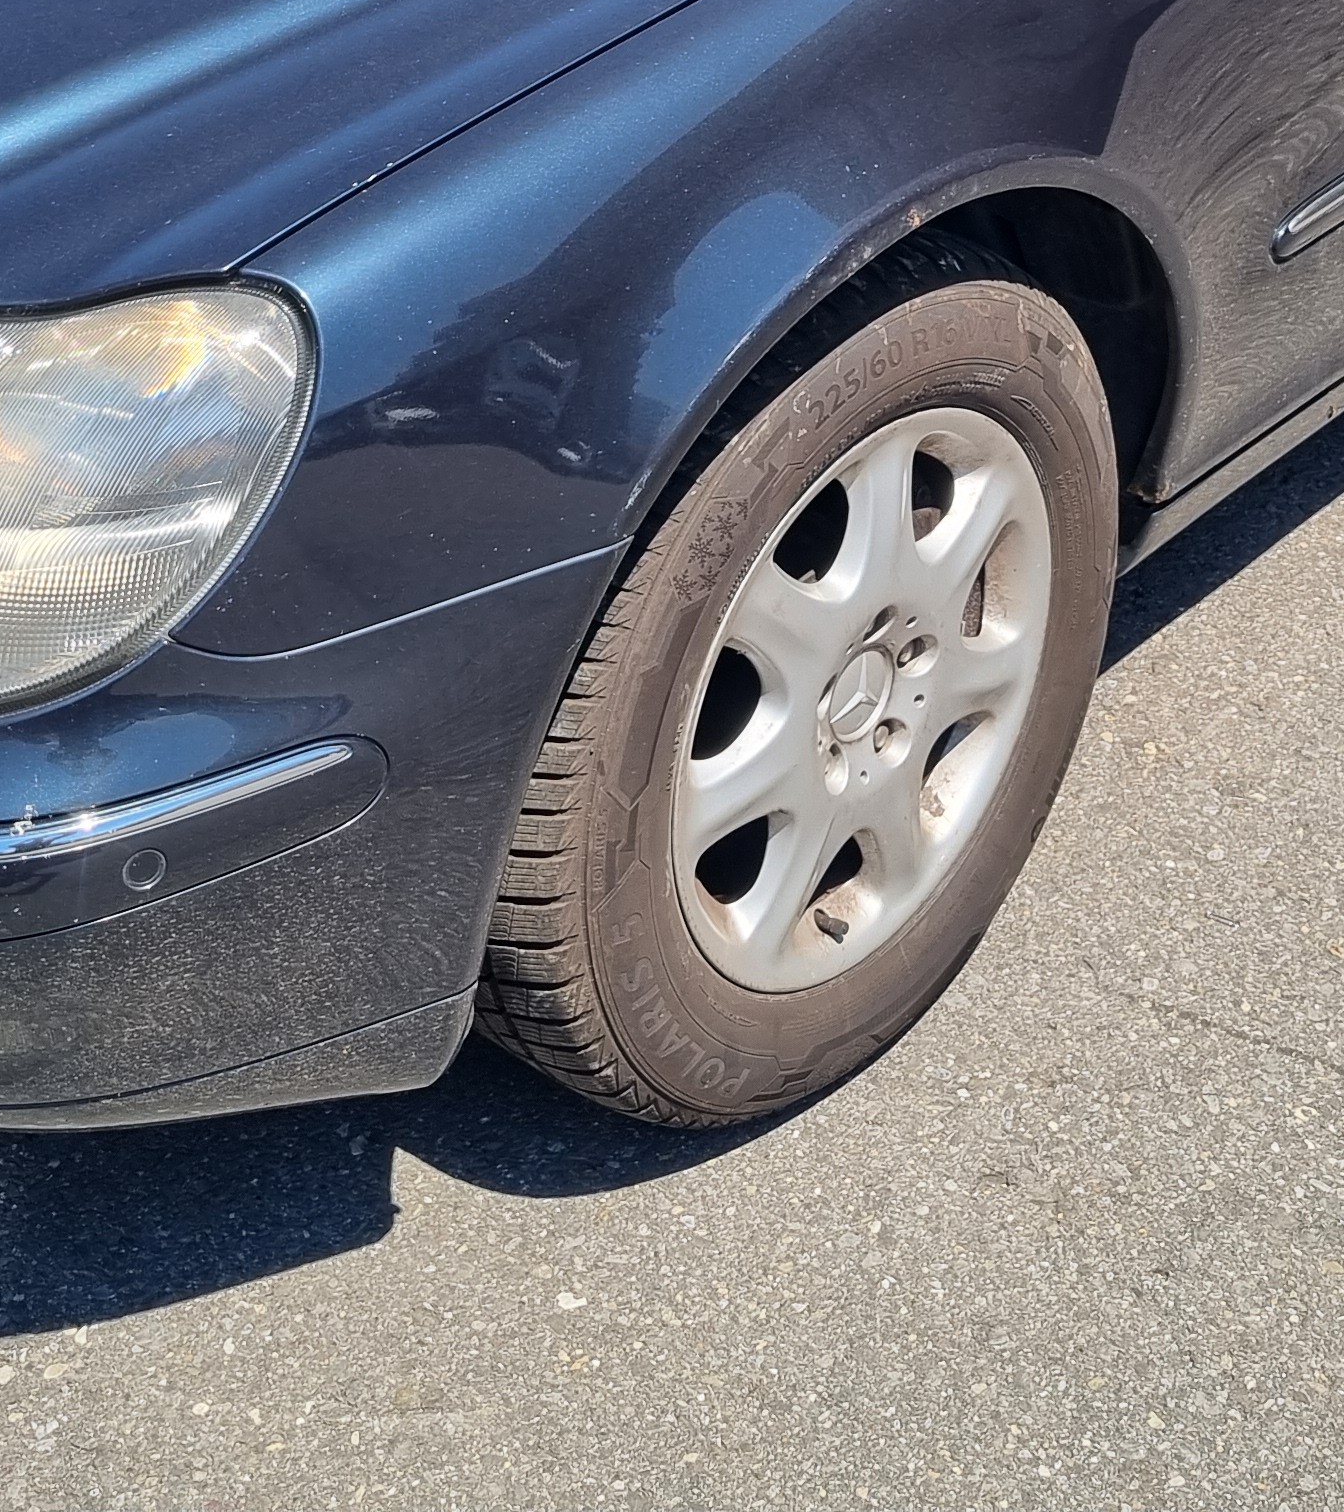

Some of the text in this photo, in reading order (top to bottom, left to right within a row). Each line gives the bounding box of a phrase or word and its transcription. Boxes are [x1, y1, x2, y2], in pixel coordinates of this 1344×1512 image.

[807, 339, 904, 431] 225/60
[910, 322, 956, 358] R16
[611, 911, 752, 1099] POLARIS 5
